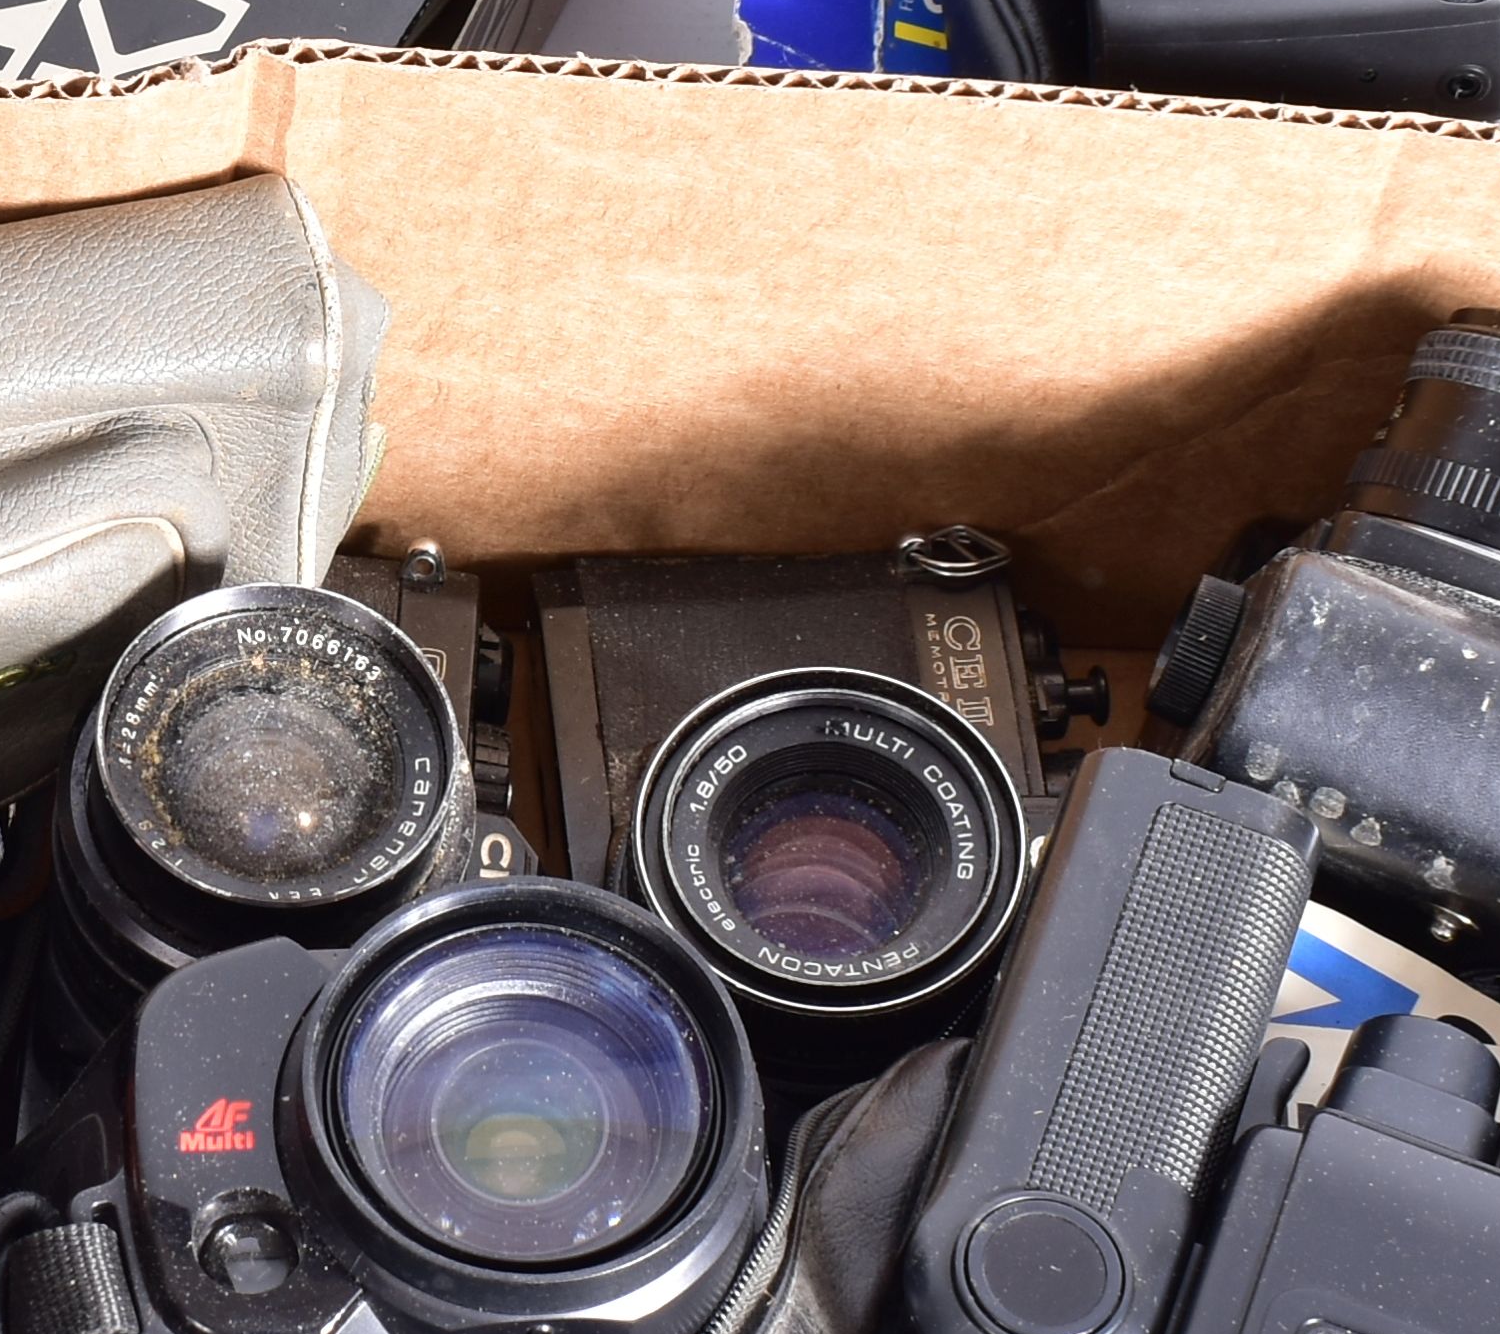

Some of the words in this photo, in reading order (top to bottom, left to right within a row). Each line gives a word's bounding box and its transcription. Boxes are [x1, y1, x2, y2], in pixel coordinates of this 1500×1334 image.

[280, 626, 382, 682] 7066163
[942, 614, 988, 690] CE
[688, 743, 749, 814] 1.8/50
[825, 718, 916, 760] MULTI
[922, 763, 975, 881] COATING
[684, 843, 736, 932] electric
[758, 941, 921, 978] PENTACON
[179, 1130, 255, 1152] Multi
[195, 1097, 252, 1132] AF
